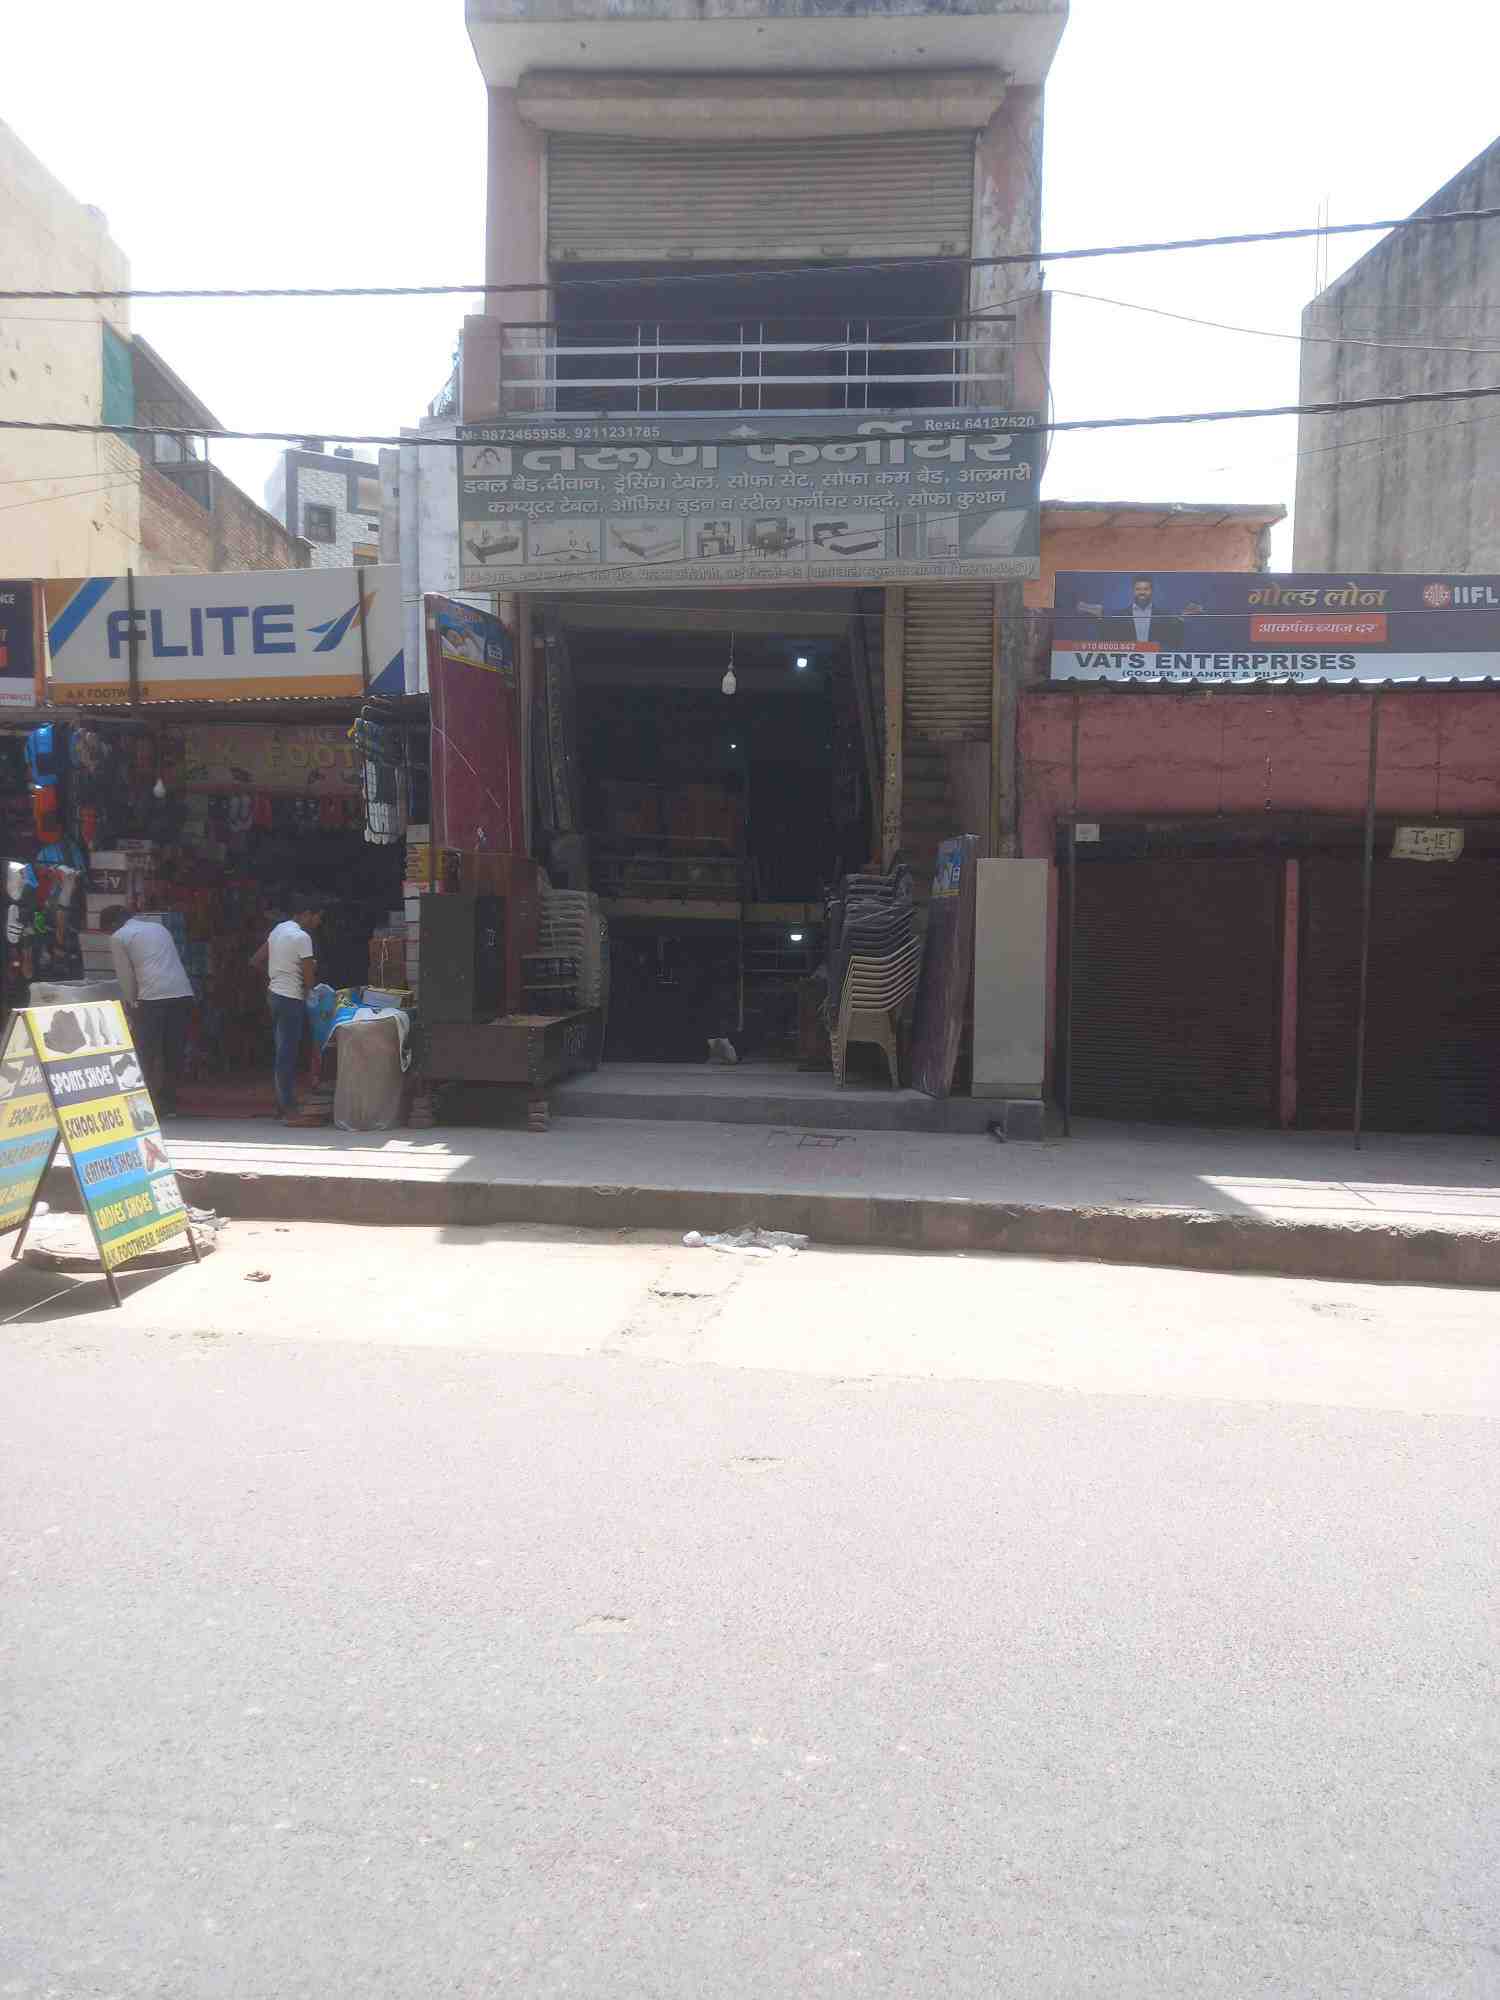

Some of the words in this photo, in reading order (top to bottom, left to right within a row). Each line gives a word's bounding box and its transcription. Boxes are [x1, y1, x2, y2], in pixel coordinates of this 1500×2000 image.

[924, 419, 960, 431] Resi:
[965, 415, 1035, 430] 64137520
[747, 420, 1020, 468] फर्नीचर
[614, 473, 666, 495] ड्रेसिंग
[959, 463, 1032, 483] अलमारी
[958, 490, 1008, 509] कुशन
[1248, 583, 1320, 608] गोल्ड
[1324, 582, 1390, 607] लोन
[1454, 586, 1499, 604] IIFL
[107, 604, 297, 659] FLITE
[1074, 653, 1145, 669] VATS
[1155, 653, 1357, 671] ENTERPRISES
[1122, 670, 1178, 678] (COOLER,
[1181, 670, 1238, 678] BLANKET
[50, 1070, 87, 1095] SPORTS
[84, 1065, 114, 1088] SHOES
[65, 1114, 101, 1139] SCHOOL
[97, 1108, 124, 1132] SHOES
